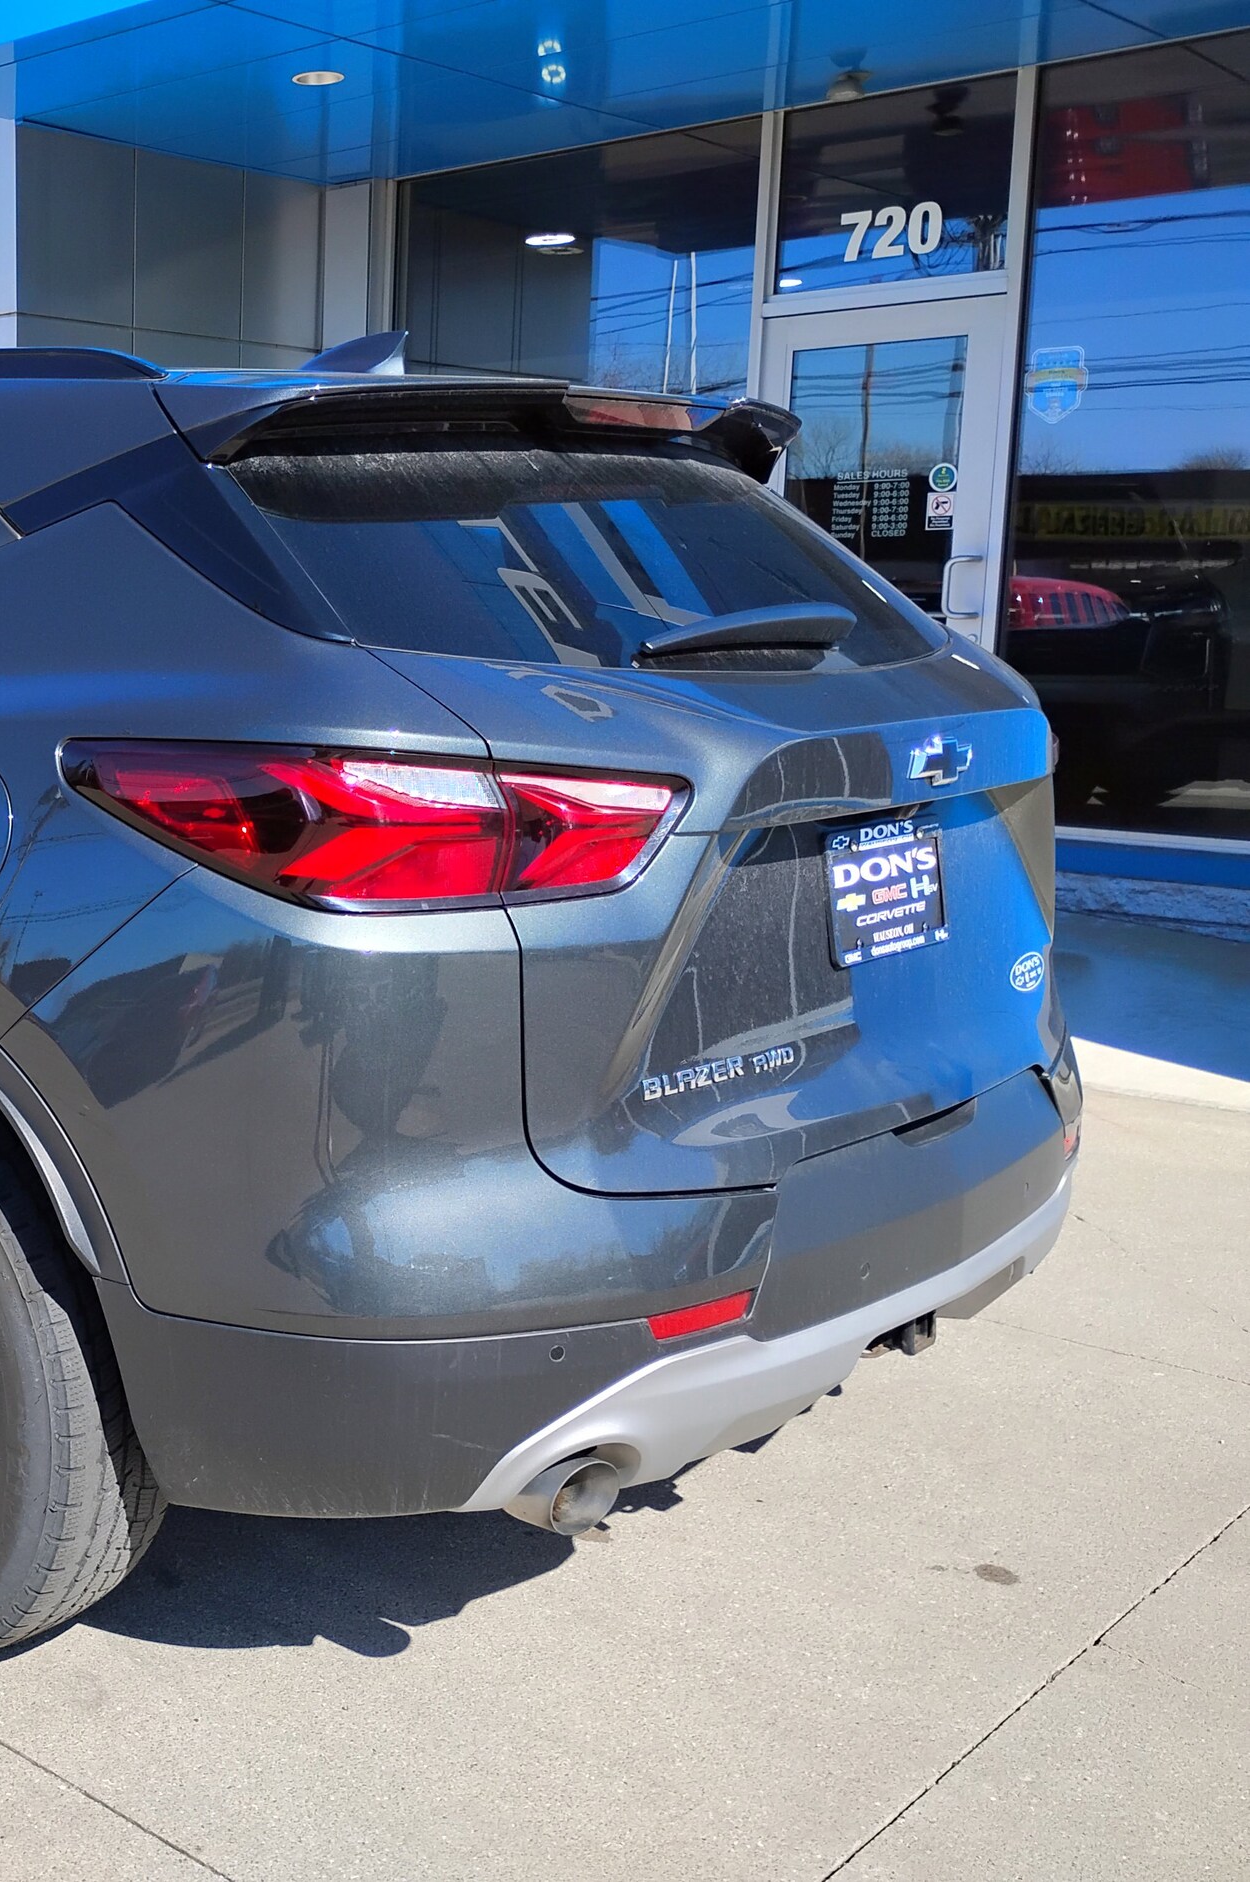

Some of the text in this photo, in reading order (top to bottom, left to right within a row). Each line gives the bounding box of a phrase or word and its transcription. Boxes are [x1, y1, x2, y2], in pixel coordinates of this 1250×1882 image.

[840, 200, 943, 263] 720
[837, 468, 909, 481] SALES HOURS
[833, 484, 860, 492] Monday
[833, 492, 860, 500] Tuesday
[832, 499, 871, 507] Wednesday
[832, 508, 862, 516] Thursday
[831, 516, 852, 524] Friday
[831, 524, 860, 532] Saturday
[870, 529, 906, 538] CLOSED
[859, 820, 914, 842] DON'S
[832, 846, 937, 889] DON'S
[871, 882, 908, 905] GMC
[856, 900, 926, 927] CORVETTE
[642, 1046, 795, 1101] BLAZER AWD
